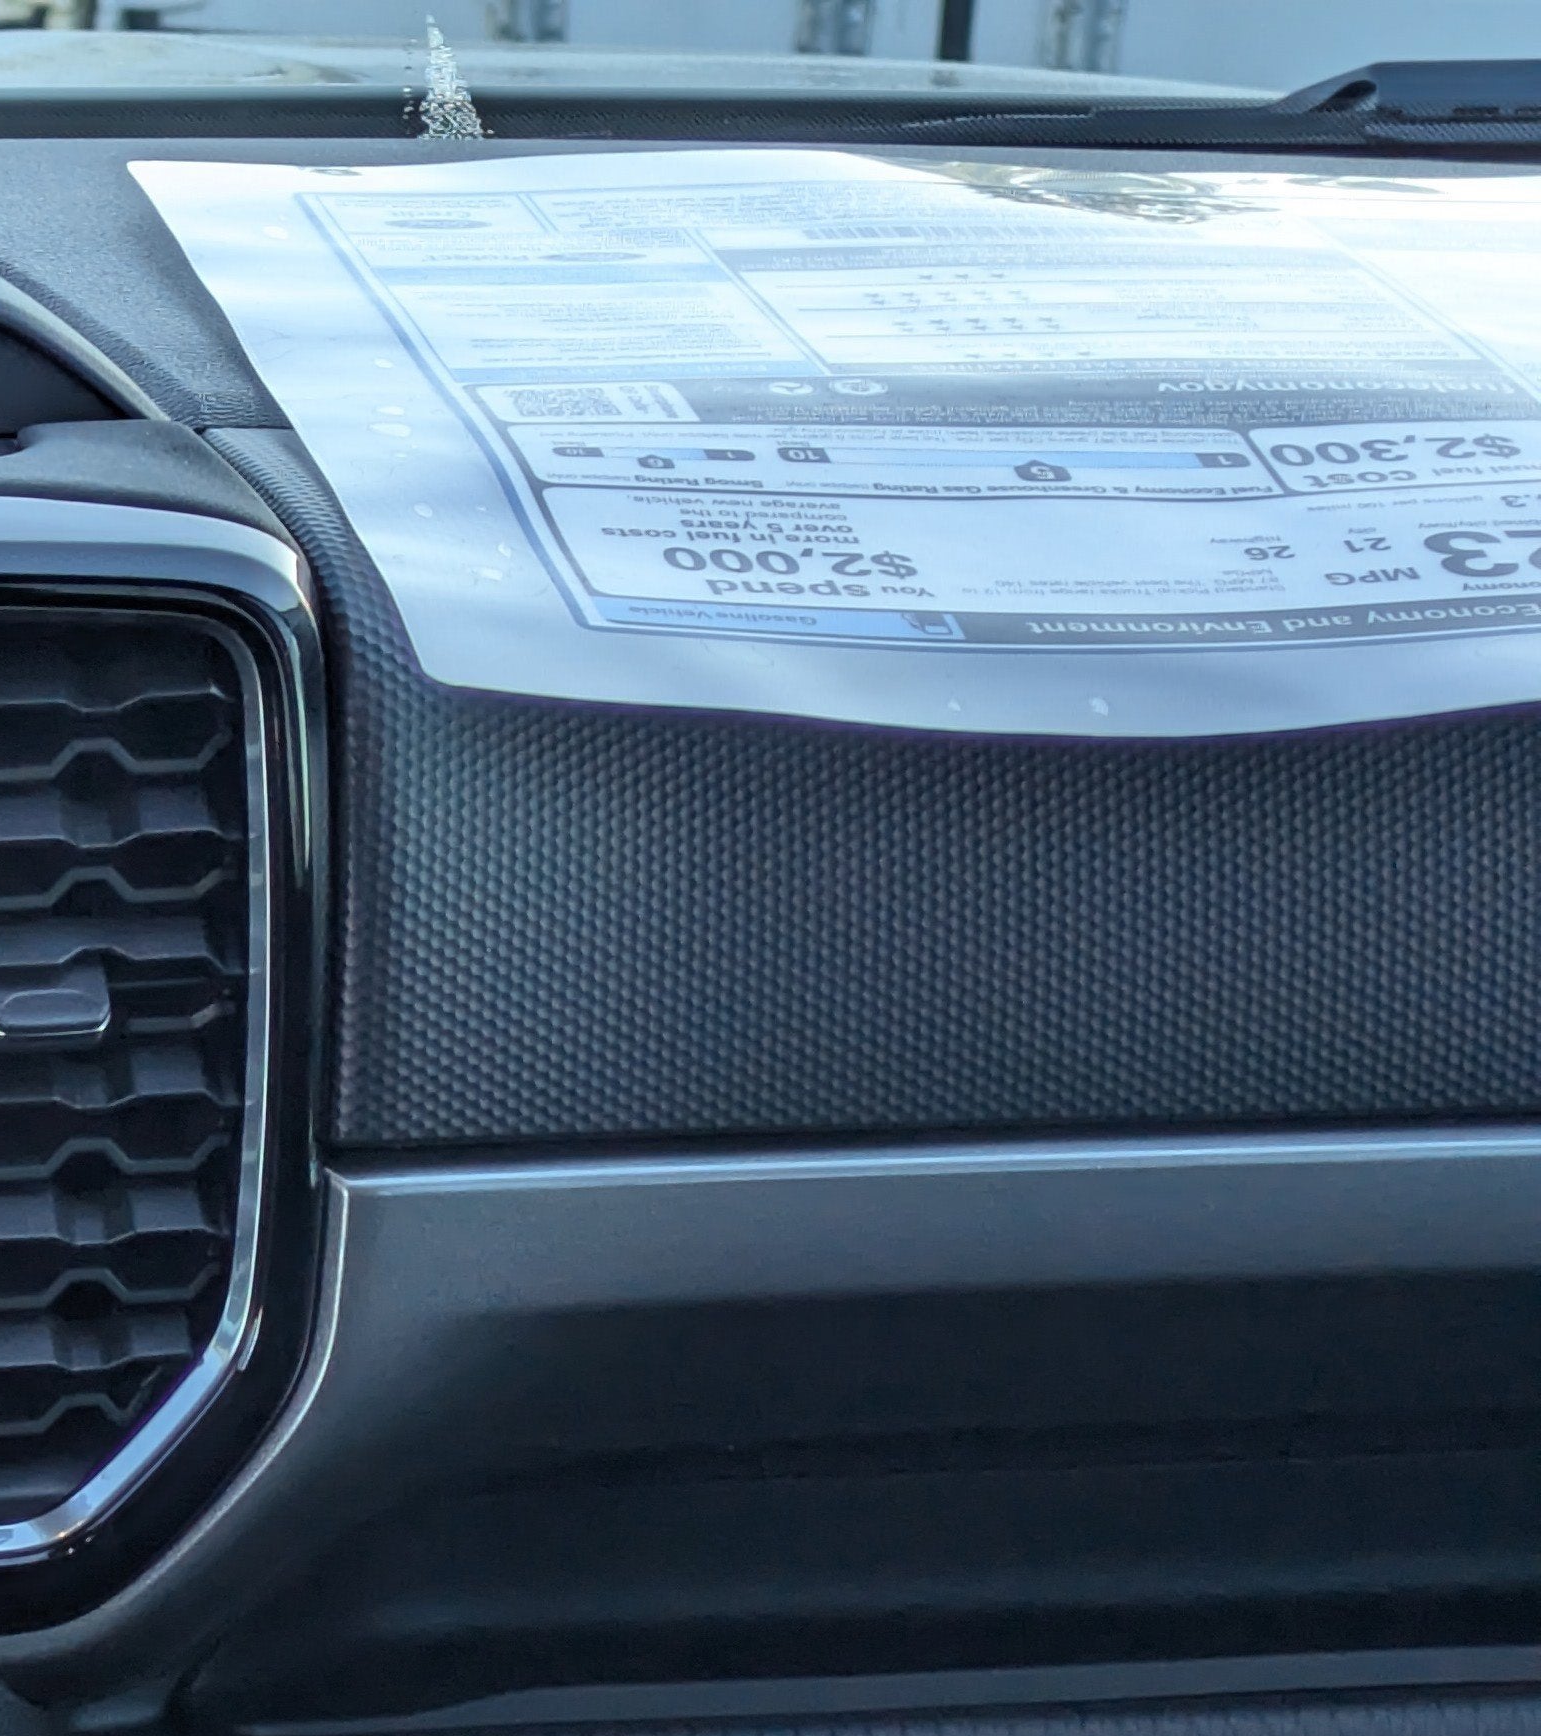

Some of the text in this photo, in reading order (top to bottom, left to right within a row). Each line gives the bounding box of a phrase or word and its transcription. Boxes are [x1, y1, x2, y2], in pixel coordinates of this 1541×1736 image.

[788, 449, 820, 460] 10
[1269, 434, 1522, 467] $2,300
[1030, 466, 1055, 480] 5
[1302, 470, 1417, 489] cost
[634, 475, 698, 487] Rating
[704, 477, 764, 488] Smog
[872, 482, 938, 494] Rating
[942, 484, 982, 494] Gas
[986, 484, 1107, 494] Greenhouse
[1134, 484, 1226, 496] Economy
[1230, 485, 1274, 494] Fuel
[715, 499, 754, 508] new
[760, 500, 841, 510] average
[679, 508, 847, 521] compared to the
[680, 519, 853, 533] over 5 years
[600, 527, 860, 545] more in fuel costs
[1343, 537, 1392, 554] 21
[1243, 545, 1296, 561] 26
[661, 547, 918, 580] $2,000
[1323, 567, 1421, 586] MPG
[705, 579, 935, 599] You spend
[628, 606, 817, 627] Gasoline Vehicle
[1025, 602, 1541, 636] Economy and Environment
